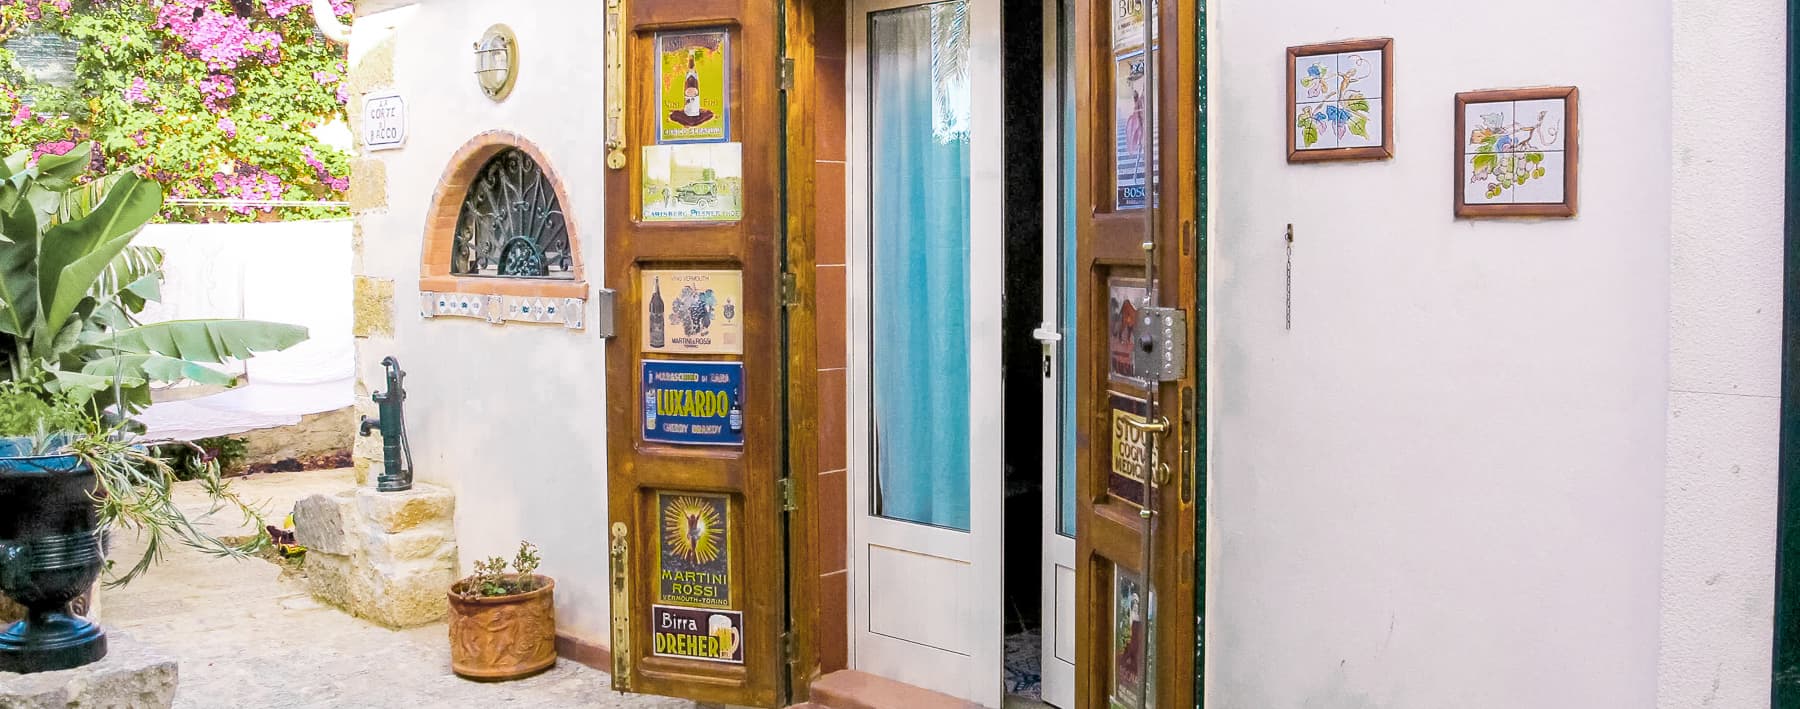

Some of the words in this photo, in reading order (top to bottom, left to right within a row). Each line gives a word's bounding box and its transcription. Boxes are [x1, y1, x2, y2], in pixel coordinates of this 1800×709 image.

[656, 388, 729, 418] LUXARDO
[663, 422, 689, 433] CHERRY
[691, 424, 722, 434] BRANDY
[662, 569, 727, 585] MARTINI
[672, 583, 717, 597] ROSSI
[661, 612, 698, 631] Birra
[656, 632, 720, 657] DREHER
